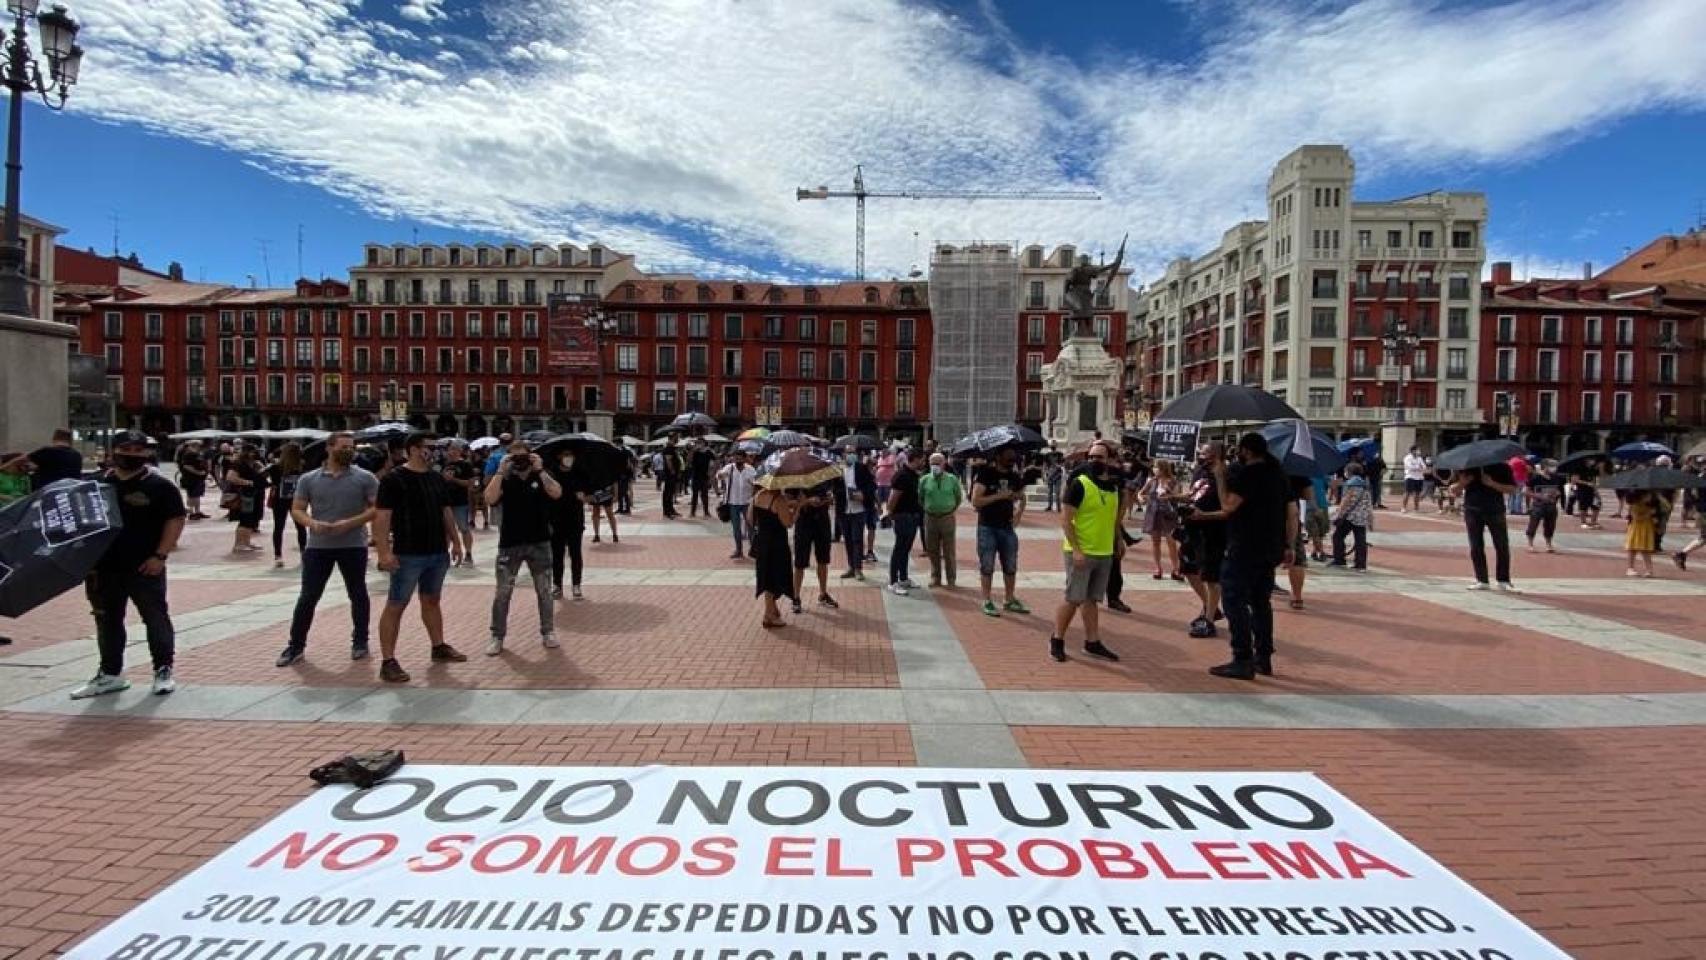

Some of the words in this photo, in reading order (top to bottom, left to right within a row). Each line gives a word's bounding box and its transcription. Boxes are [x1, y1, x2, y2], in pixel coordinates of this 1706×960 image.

[331, 777, 634, 824] OCIO
[657, 779, 1335, 831] NOCTURNO
[247, 832, 399, 870] NO
[407, 835, 738, 876] SOMOS
[764, 837, 873, 877] EL
[896, 838, 1414, 880] PROBLEMA
[182, 894, 376, 926] 300.000
[370, 899, 592, 931] FAMILIAS
[597, 902, 878, 935] DESPEDIDAS
[888, 904, 914, 936] Y
[927, 904, 994, 936] NO
[1006, 904, 1106, 936] POR
[1107, 905, 1167, 936] EL
[1164, 906, 1476, 936] EMPRESARIO.
